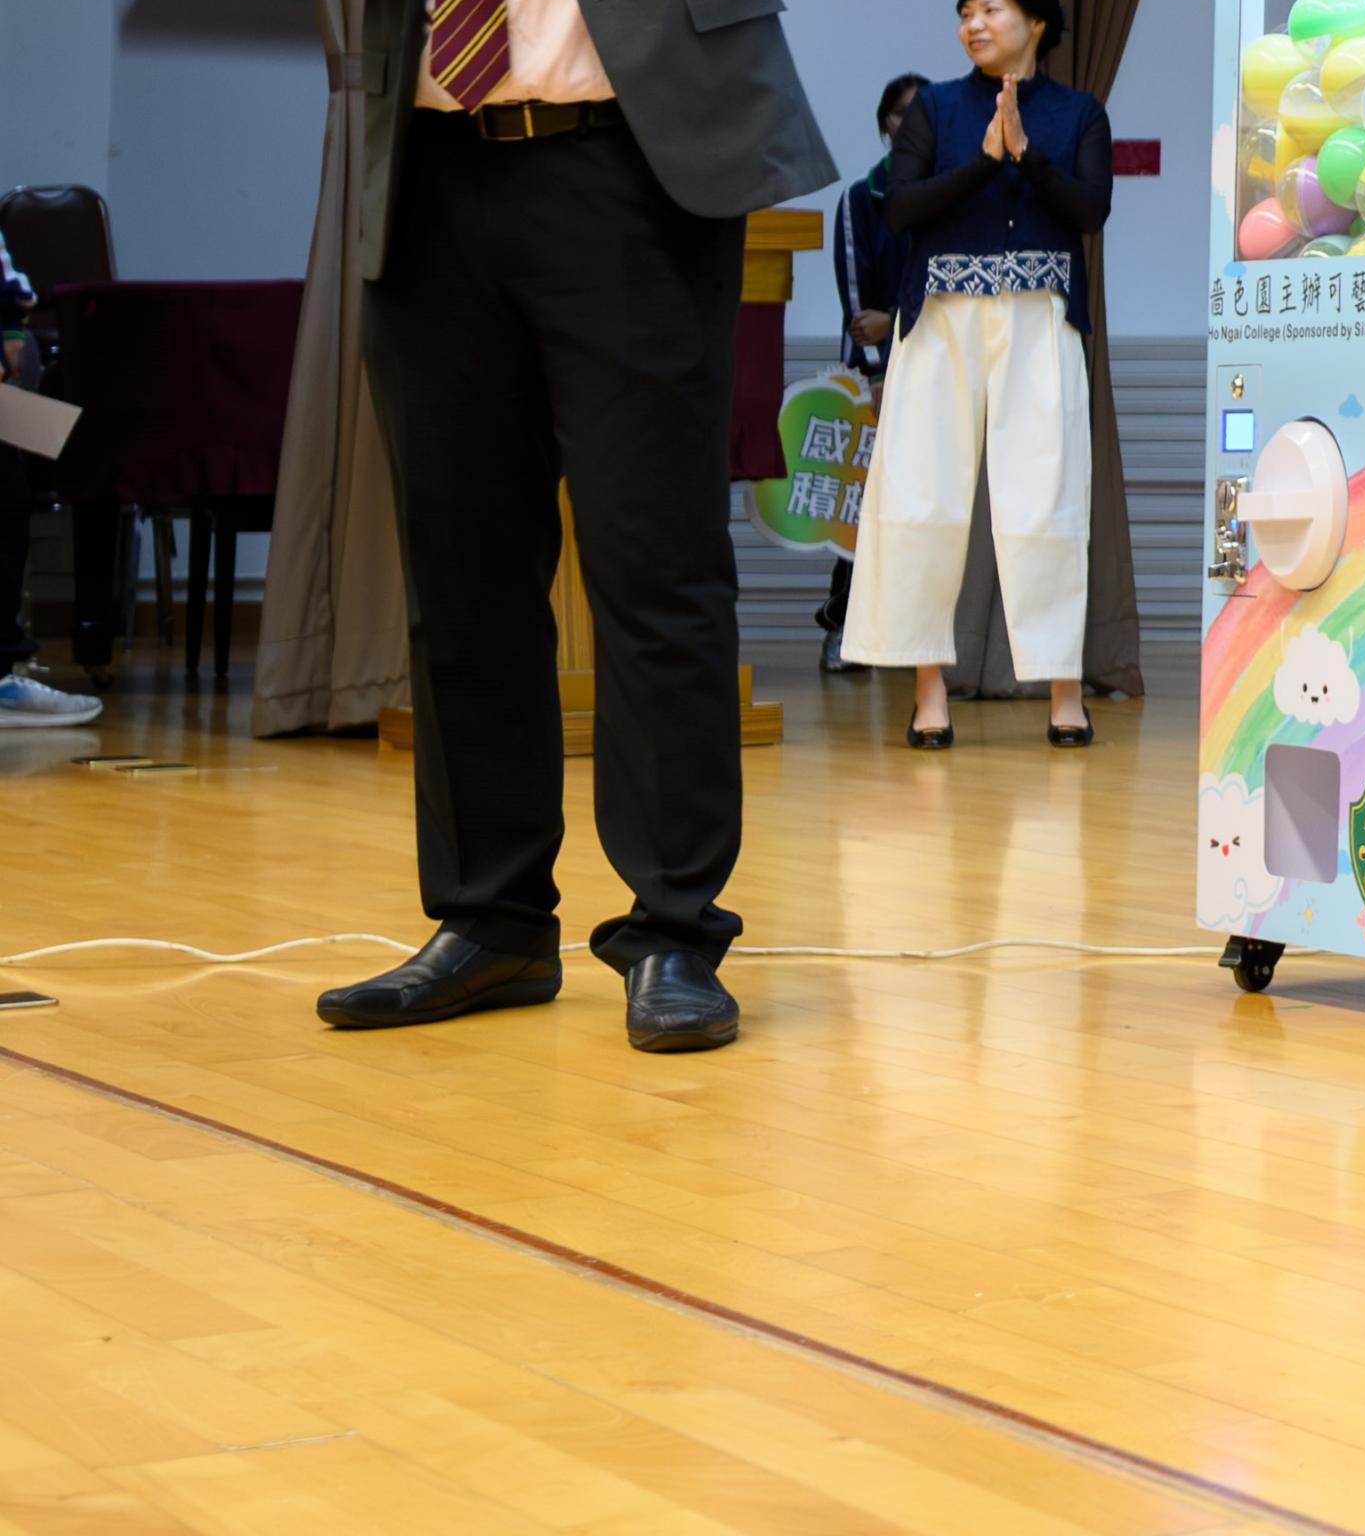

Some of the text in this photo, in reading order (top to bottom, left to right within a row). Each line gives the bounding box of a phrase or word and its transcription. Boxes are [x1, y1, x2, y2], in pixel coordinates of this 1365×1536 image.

[1221, 325, 1243, 344] Ngai
[1244, 323, 1281, 342] College
[1282, 322, 1339, 342] (Sponsored
[1340, 321, 1352, 339] by
